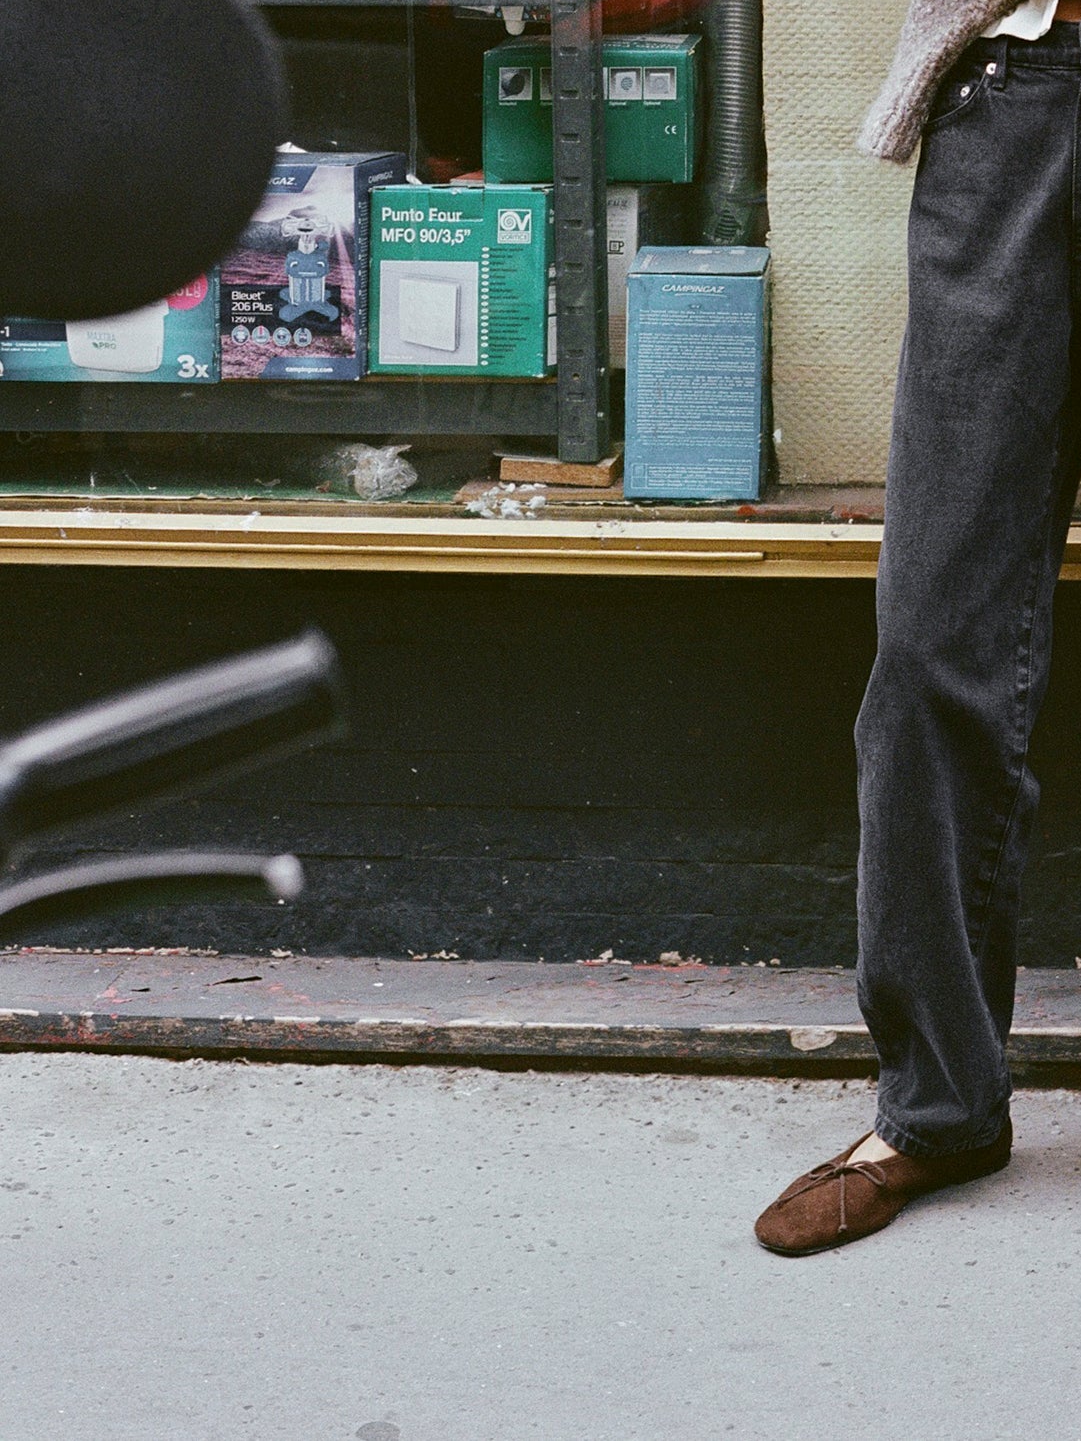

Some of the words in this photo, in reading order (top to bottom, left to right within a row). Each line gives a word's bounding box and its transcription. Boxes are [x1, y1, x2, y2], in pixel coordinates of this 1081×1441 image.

[381, 207, 424, 222] Punto
[429, 207, 462, 222] Four
[381, 228, 416, 243] MFO
[661, 284, 725, 294] CAMPINGAZ
[231, 301, 251, 311] 206
[252, 301, 273, 312] Plus
[87, 332, 116, 342] MAXTRA
[99, 342, 117, 350] PRO
[177, 354, 209, 379] 3x
[285, 366, 333, 374] campingaz.com
